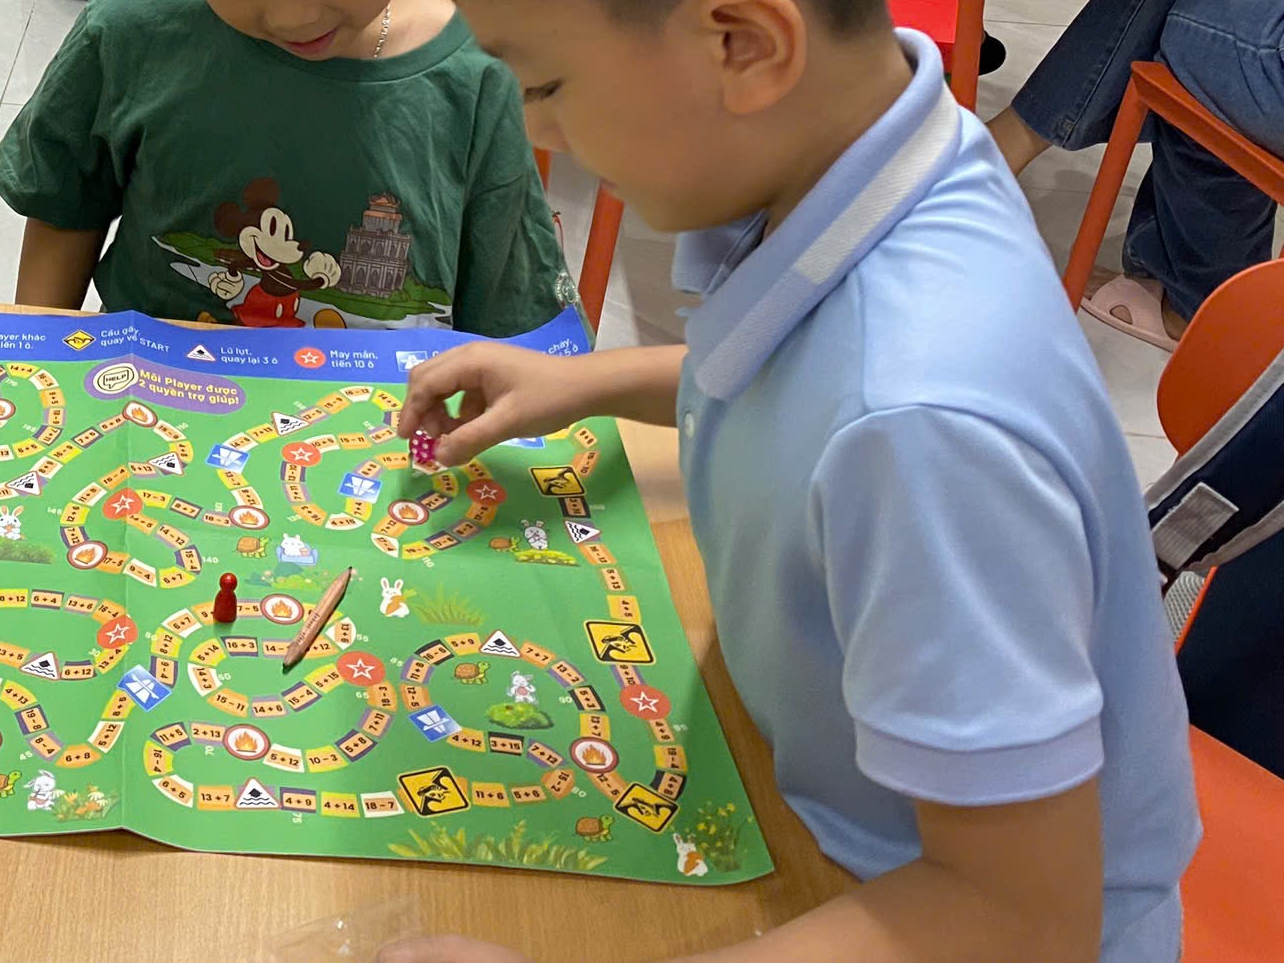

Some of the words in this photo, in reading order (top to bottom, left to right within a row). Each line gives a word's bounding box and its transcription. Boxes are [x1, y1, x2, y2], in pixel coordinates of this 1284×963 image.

[101, 336, 124, 347] quay
[140, 338, 170, 352] START
[331, 350, 350, 360] May
[221, 356, 246, 366] quay
[354, 360, 365, 368] 10
[105, 374, 127, 383] HELP
[165, 376, 202, 391] Player
